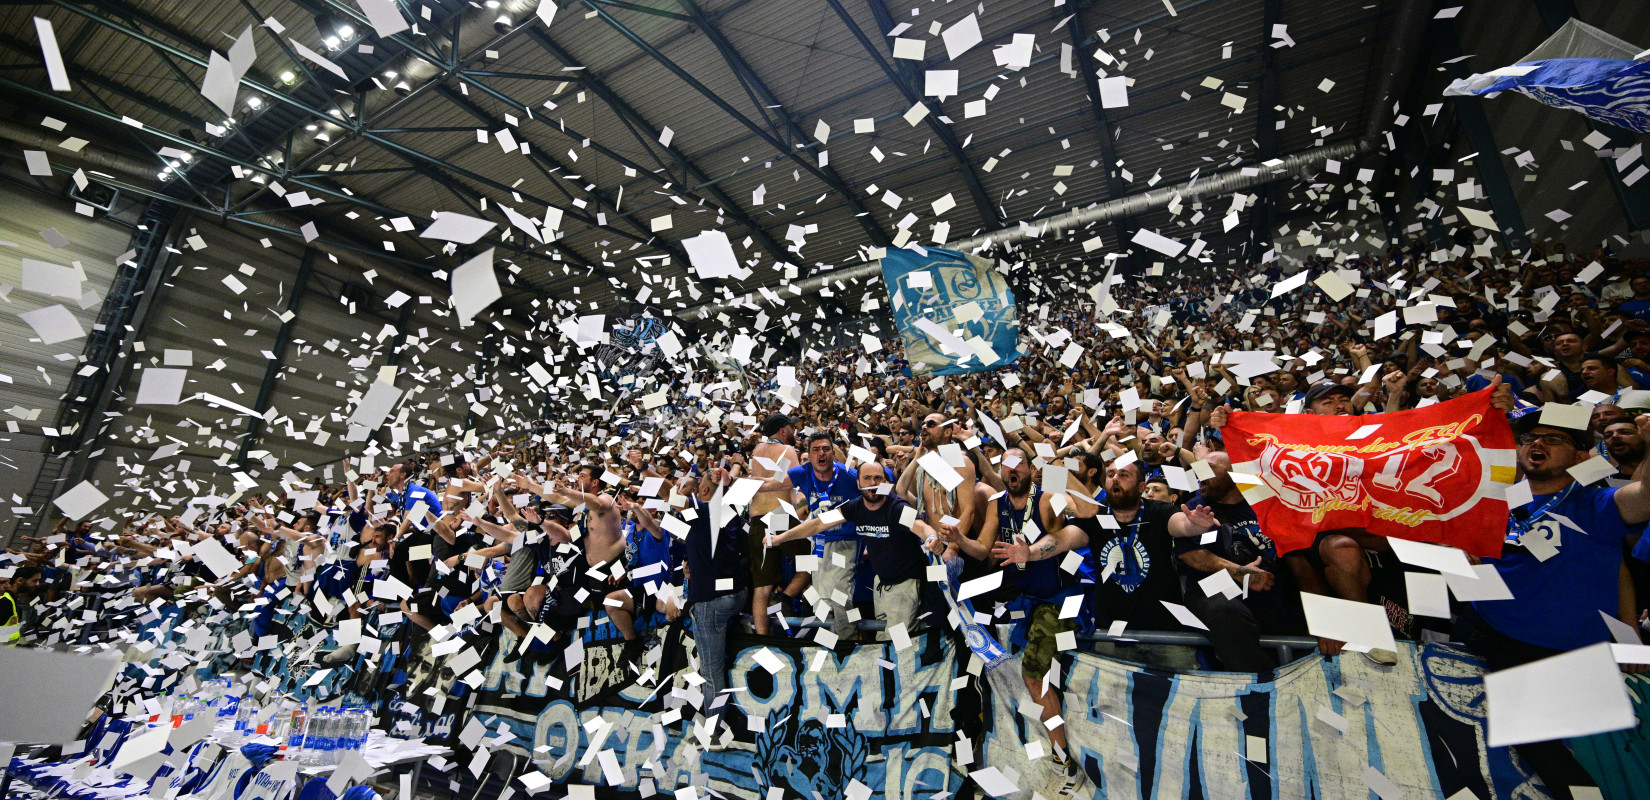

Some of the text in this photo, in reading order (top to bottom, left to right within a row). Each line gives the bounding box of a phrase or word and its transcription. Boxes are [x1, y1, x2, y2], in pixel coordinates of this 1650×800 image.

[1356, 436, 1401, 453] der
[1372, 442, 1463, 508] 12
[481, 625, 959, 737] ΑΥΟΜΗ
